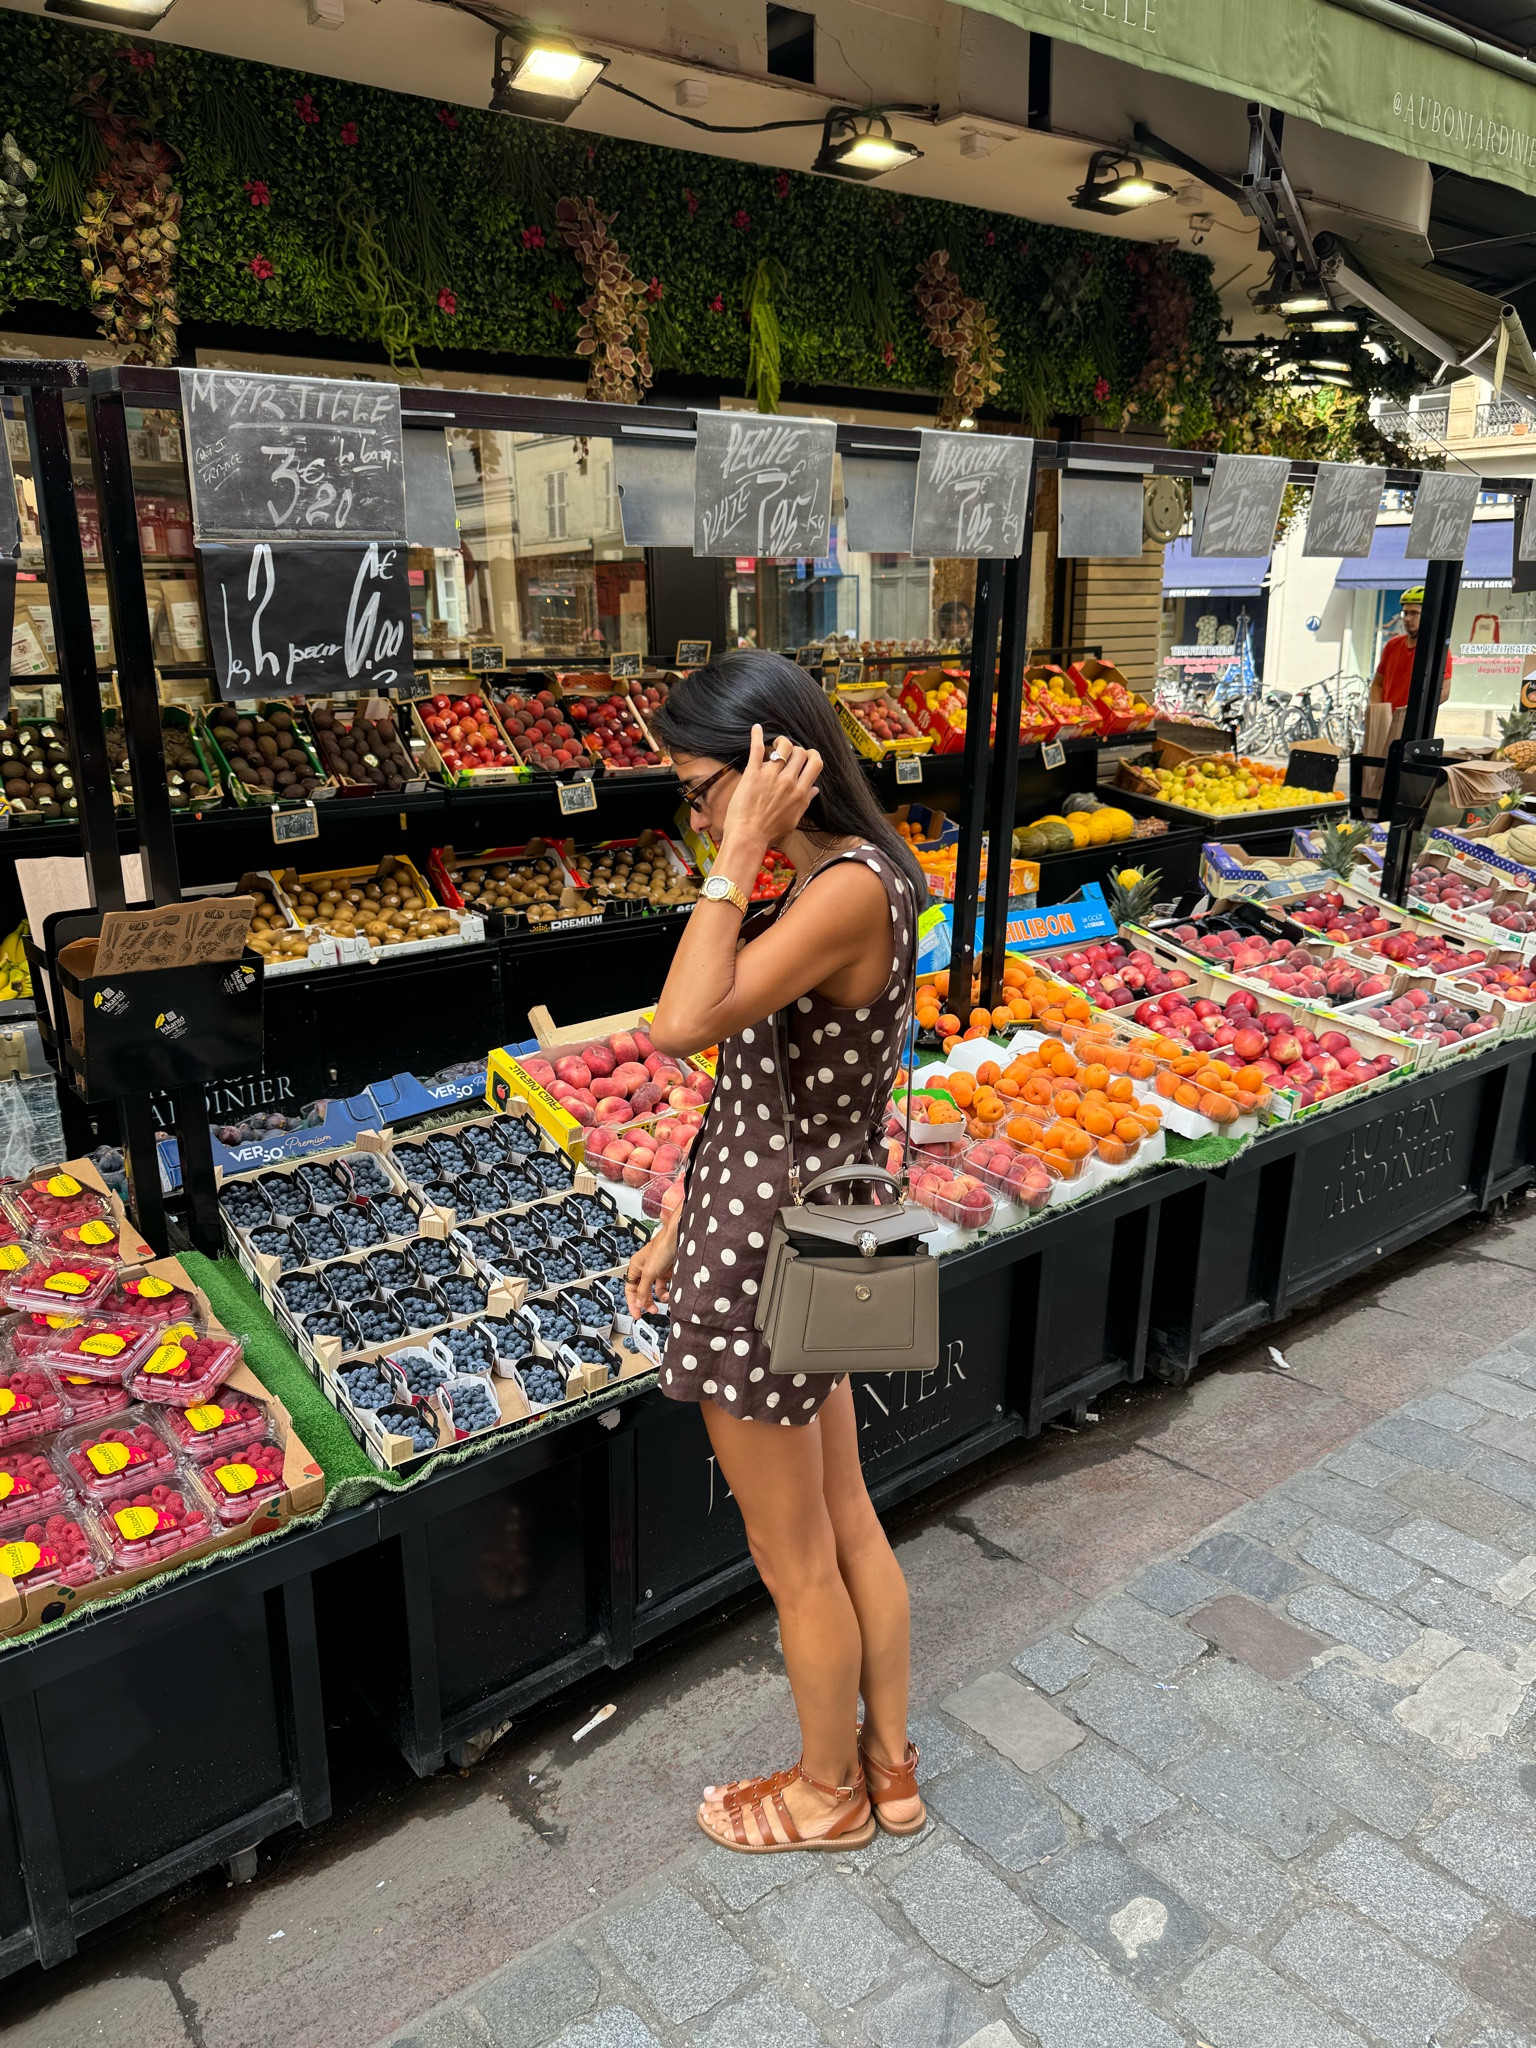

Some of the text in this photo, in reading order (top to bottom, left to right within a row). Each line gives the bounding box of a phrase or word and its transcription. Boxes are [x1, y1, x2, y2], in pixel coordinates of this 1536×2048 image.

[191, 373, 394, 423] MYRTILLE
[551, 914, 603, 931] PREMIUM
[427, 1084, 472, 1099] VERSO
[229, 1132, 332, 1162] VERSO Premium
[1340, 1093, 1446, 1169] AU BON
[1317, 1130, 1454, 1234] JARDINIER
